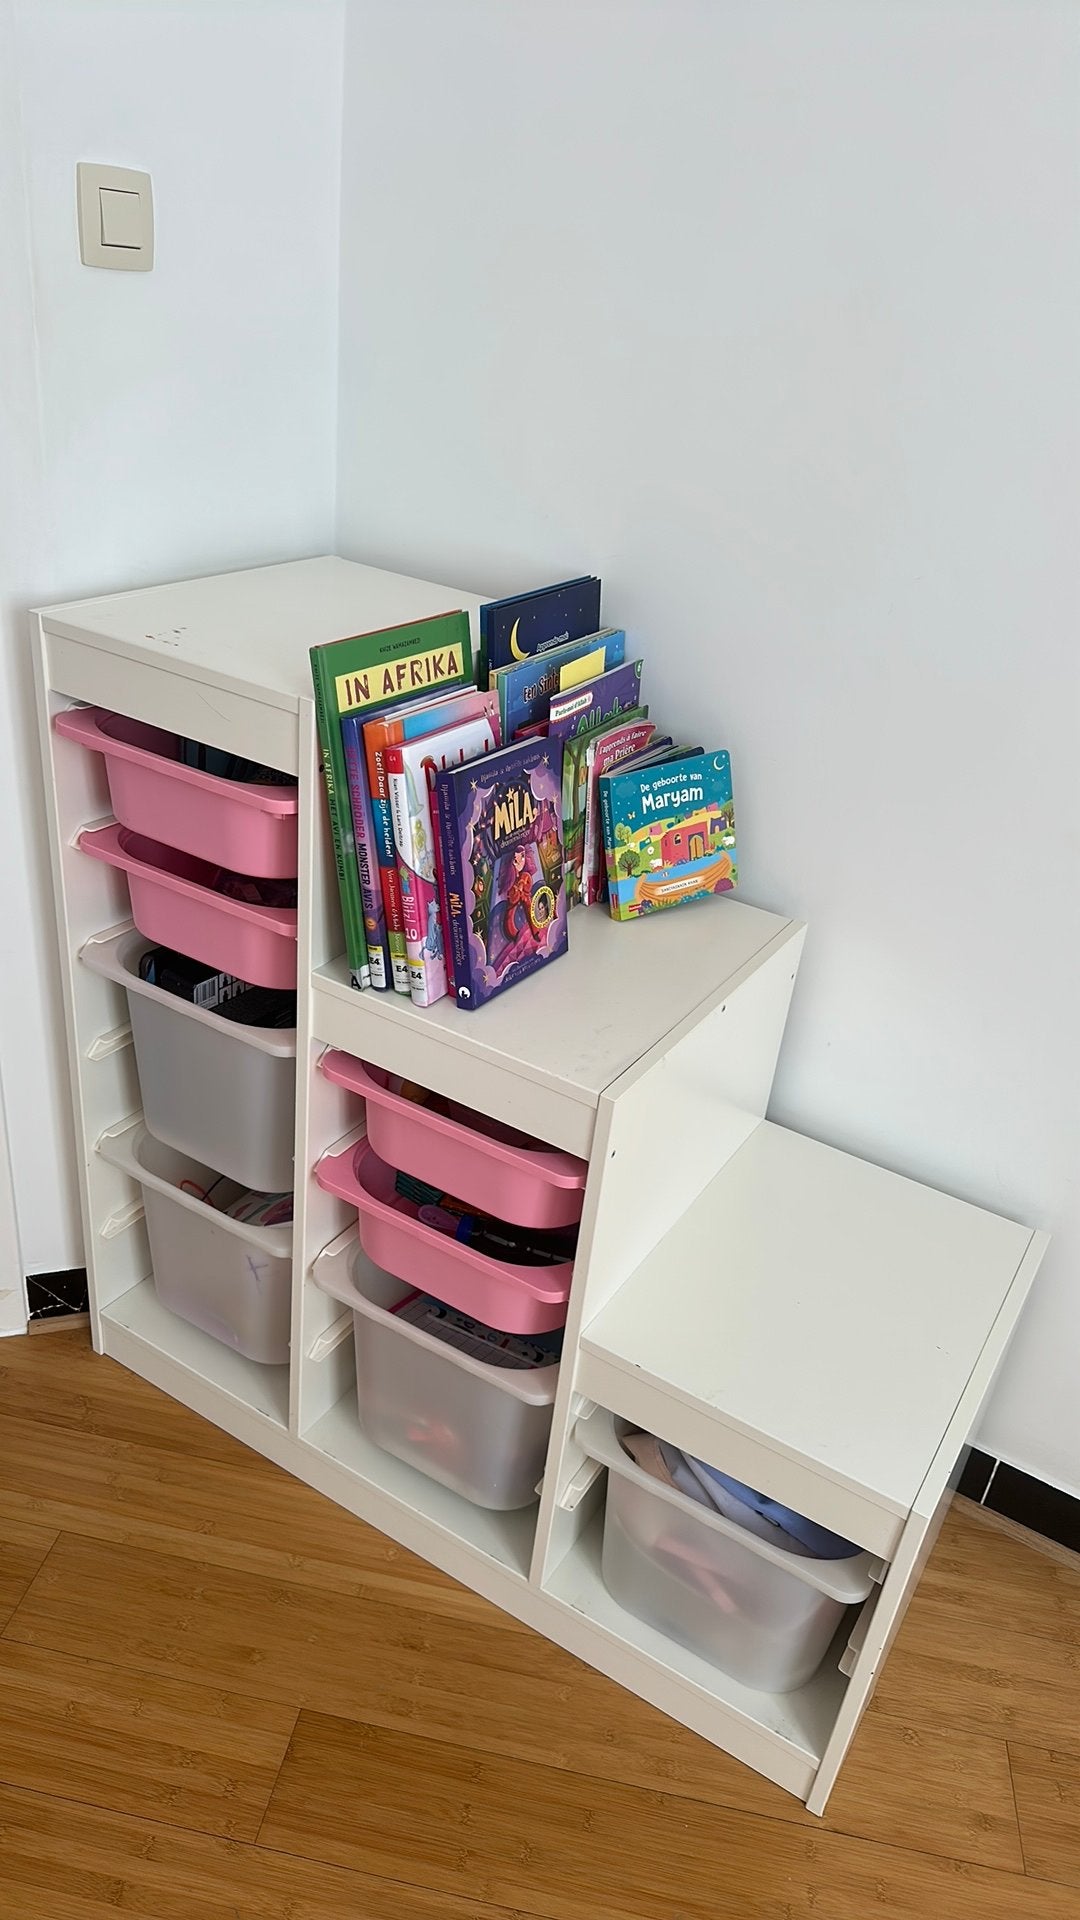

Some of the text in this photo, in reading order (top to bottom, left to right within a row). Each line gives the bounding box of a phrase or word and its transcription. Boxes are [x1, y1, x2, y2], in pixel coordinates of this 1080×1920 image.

[345, 650, 459, 706] IN AFRIKA
[522, 683, 538, 704] Een
[322, 748, 330, 758] IN
[603, 744, 636, 766] ma Prière
[324, 762, 335, 795] AFRIKA
[640, 773, 703, 793] De geboorte van
[329, 800, 338, 817] MET
[352, 784, 366, 839] SCHRÖDER
[374, 751, 394, 858] Zoef! Daar zijn de helden!
[603, 798, 611, 824] geboorte
[641, 787, 704, 814] Maryam
[332, 822, 340, 836] AVI
[334, 839, 343, 850] EN
[357, 843, 371, 885] MONSTER
[363, 886, 373, 910] AVIS
[401, 895, 416, 923] Blitz!
[404, 927, 418, 940] 10
[411, 971, 422, 980] E4
